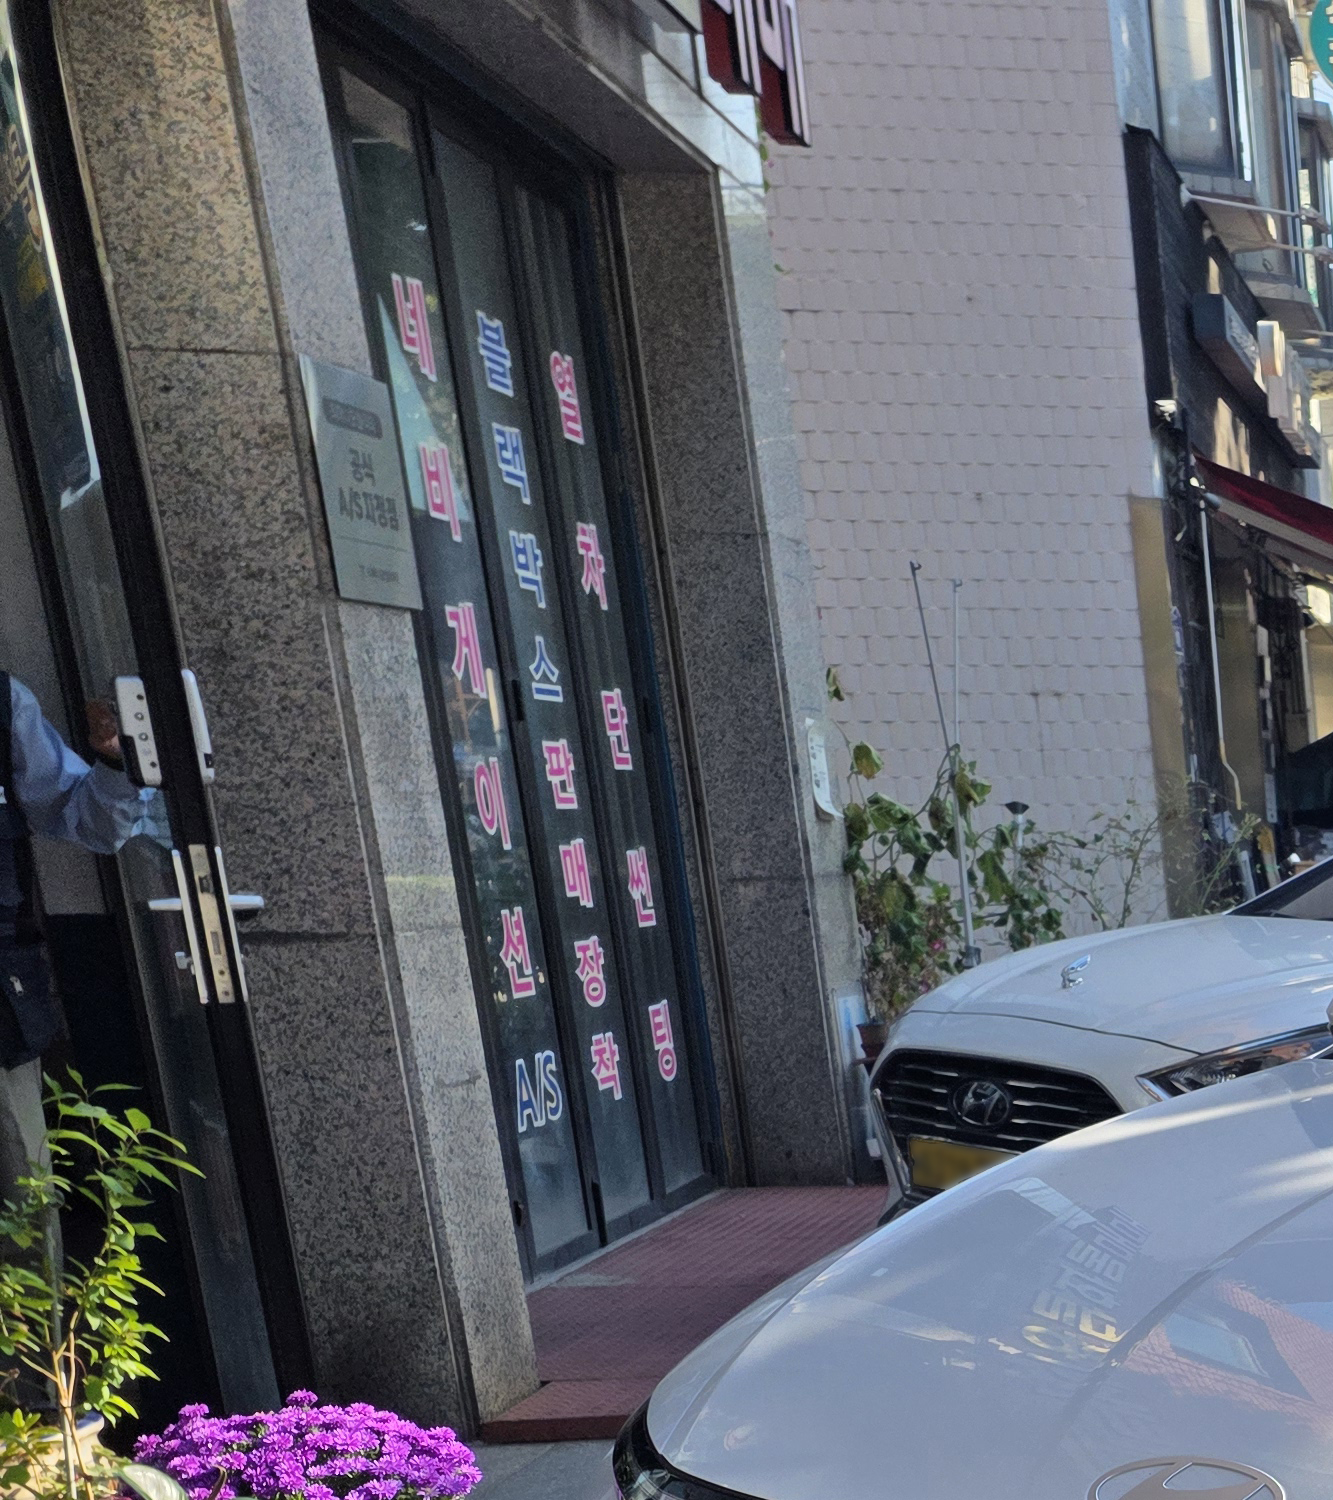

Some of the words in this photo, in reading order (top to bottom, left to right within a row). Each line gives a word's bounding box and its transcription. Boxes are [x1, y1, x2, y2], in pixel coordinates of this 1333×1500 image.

[391, 272, 536, 998] 네비게이션
[476, 309, 563, 702] 블랙박스
[515, 1050, 563, 1133] A/S
